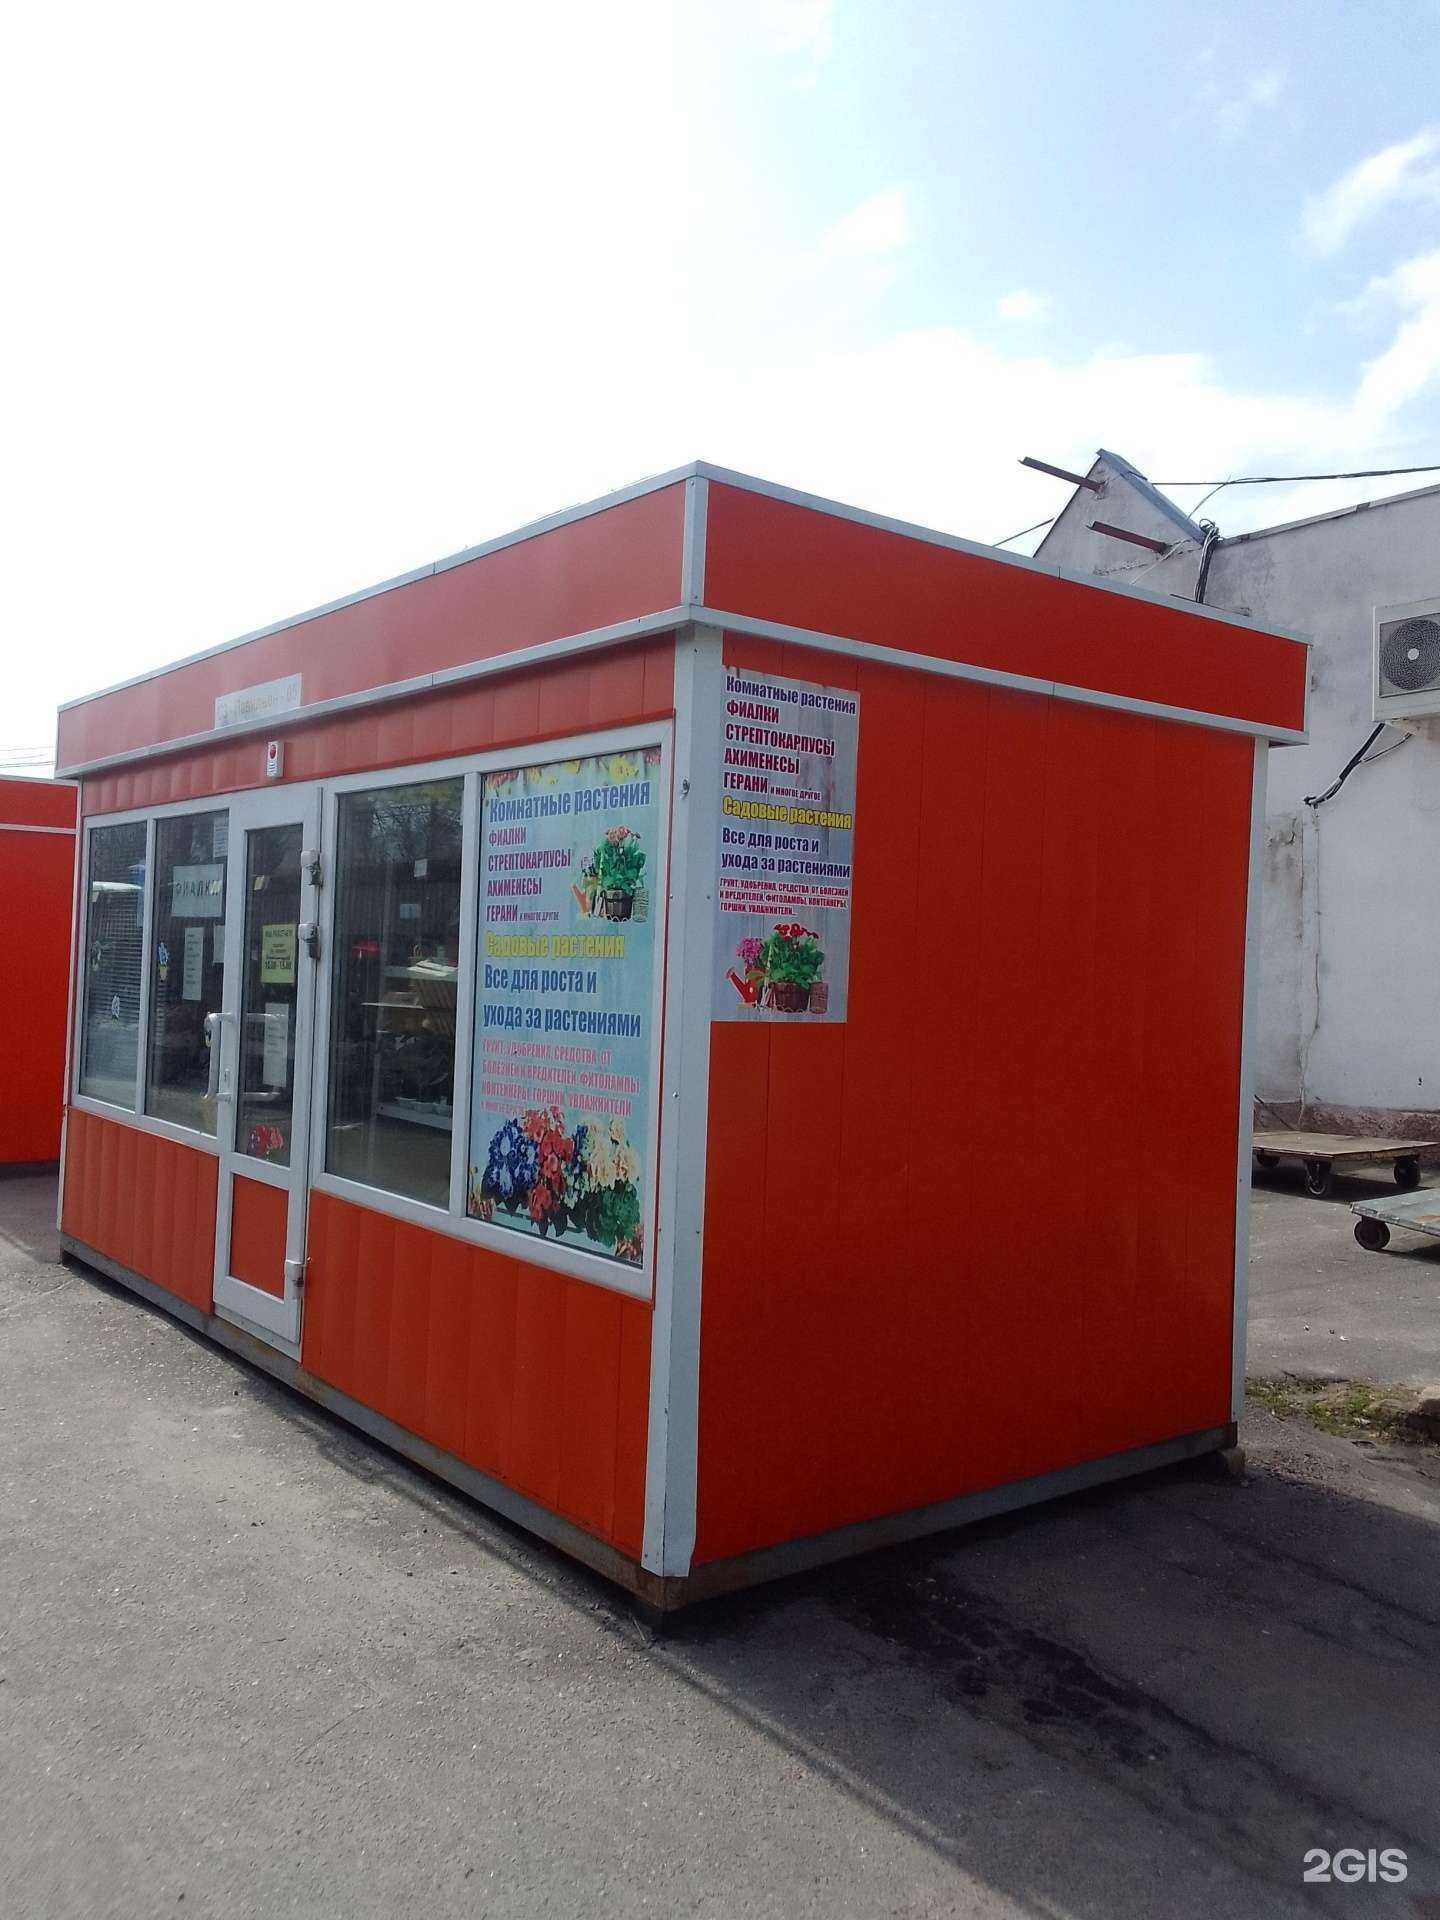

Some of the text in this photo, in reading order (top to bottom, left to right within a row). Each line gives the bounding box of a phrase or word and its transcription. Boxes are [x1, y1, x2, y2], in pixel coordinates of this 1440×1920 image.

[726, 675, 856, 714] Комнатные растения
[726, 699, 779, 724] ФИАЛКИ
[725, 723, 835, 757] СТРЕПТОКАРПУСЫ
[724, 747, 800, 774] АХИМЕНЕСЫ
[723, 772, 768, 793] ГЕРАНИ
[489, 781, 651, 823] Комнатные растения
[722, 795, 852, 829] Садовые растения
[488, 826, 527, 846] ФИАЛКИ
[722, 827, 819, 853] Все для роста и
[488, 848, 571, 872] СТРЕПТОКАРПУСЫ
[721, 853, 850, 878] ухода за растениями
[487, 877, 542, 897] АХИМЕНЕСЫ
[778, 883, 809, 894] СРЕДСТВА
[811, 886, 818, 894] ОТ
[486, 905, 518, 922] ГЕРАНИ
[486, 931, 625, 960] Садовые растения
[485, 964, 597, 993] Все для роста и
[483, 1004, 641, 1037] ухода за растениями
